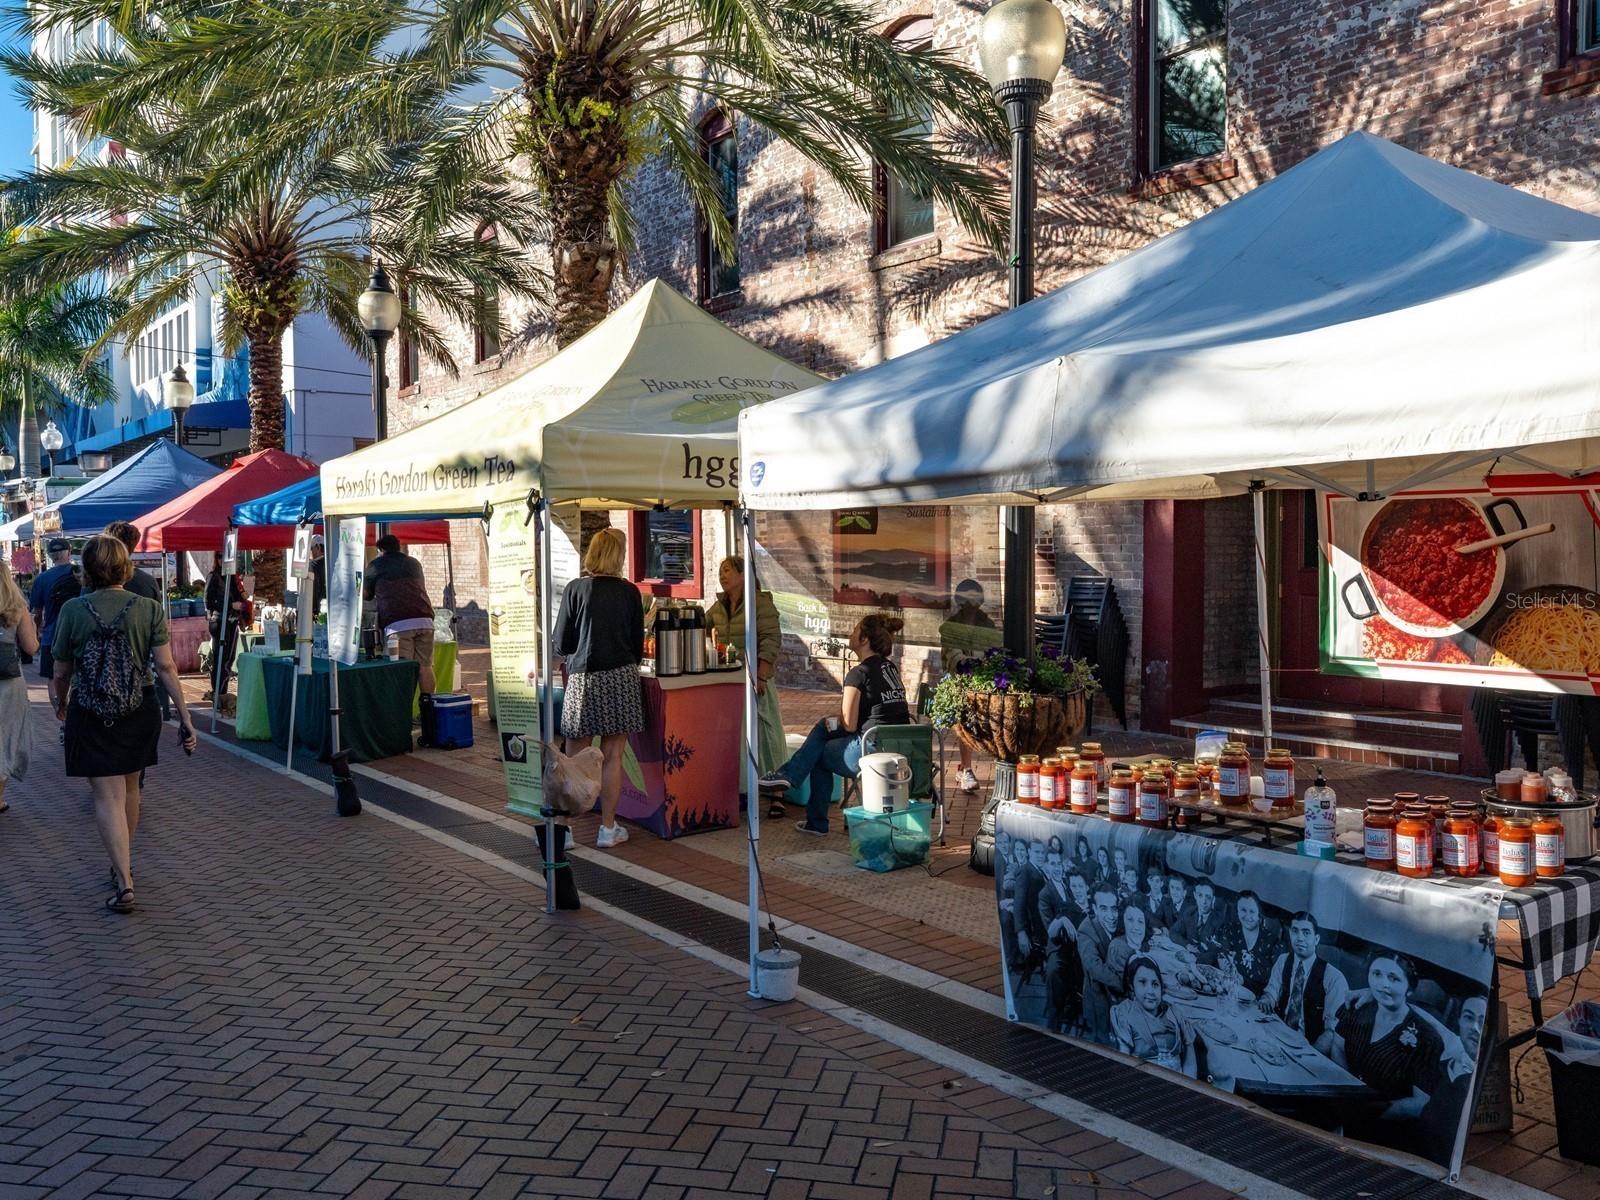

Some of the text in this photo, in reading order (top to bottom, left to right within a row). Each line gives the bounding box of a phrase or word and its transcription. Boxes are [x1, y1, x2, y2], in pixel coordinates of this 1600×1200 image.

[693, 393, 746, 405] GREEN
[335, 454, 515, 499] Haraki Gordon Green Tea
